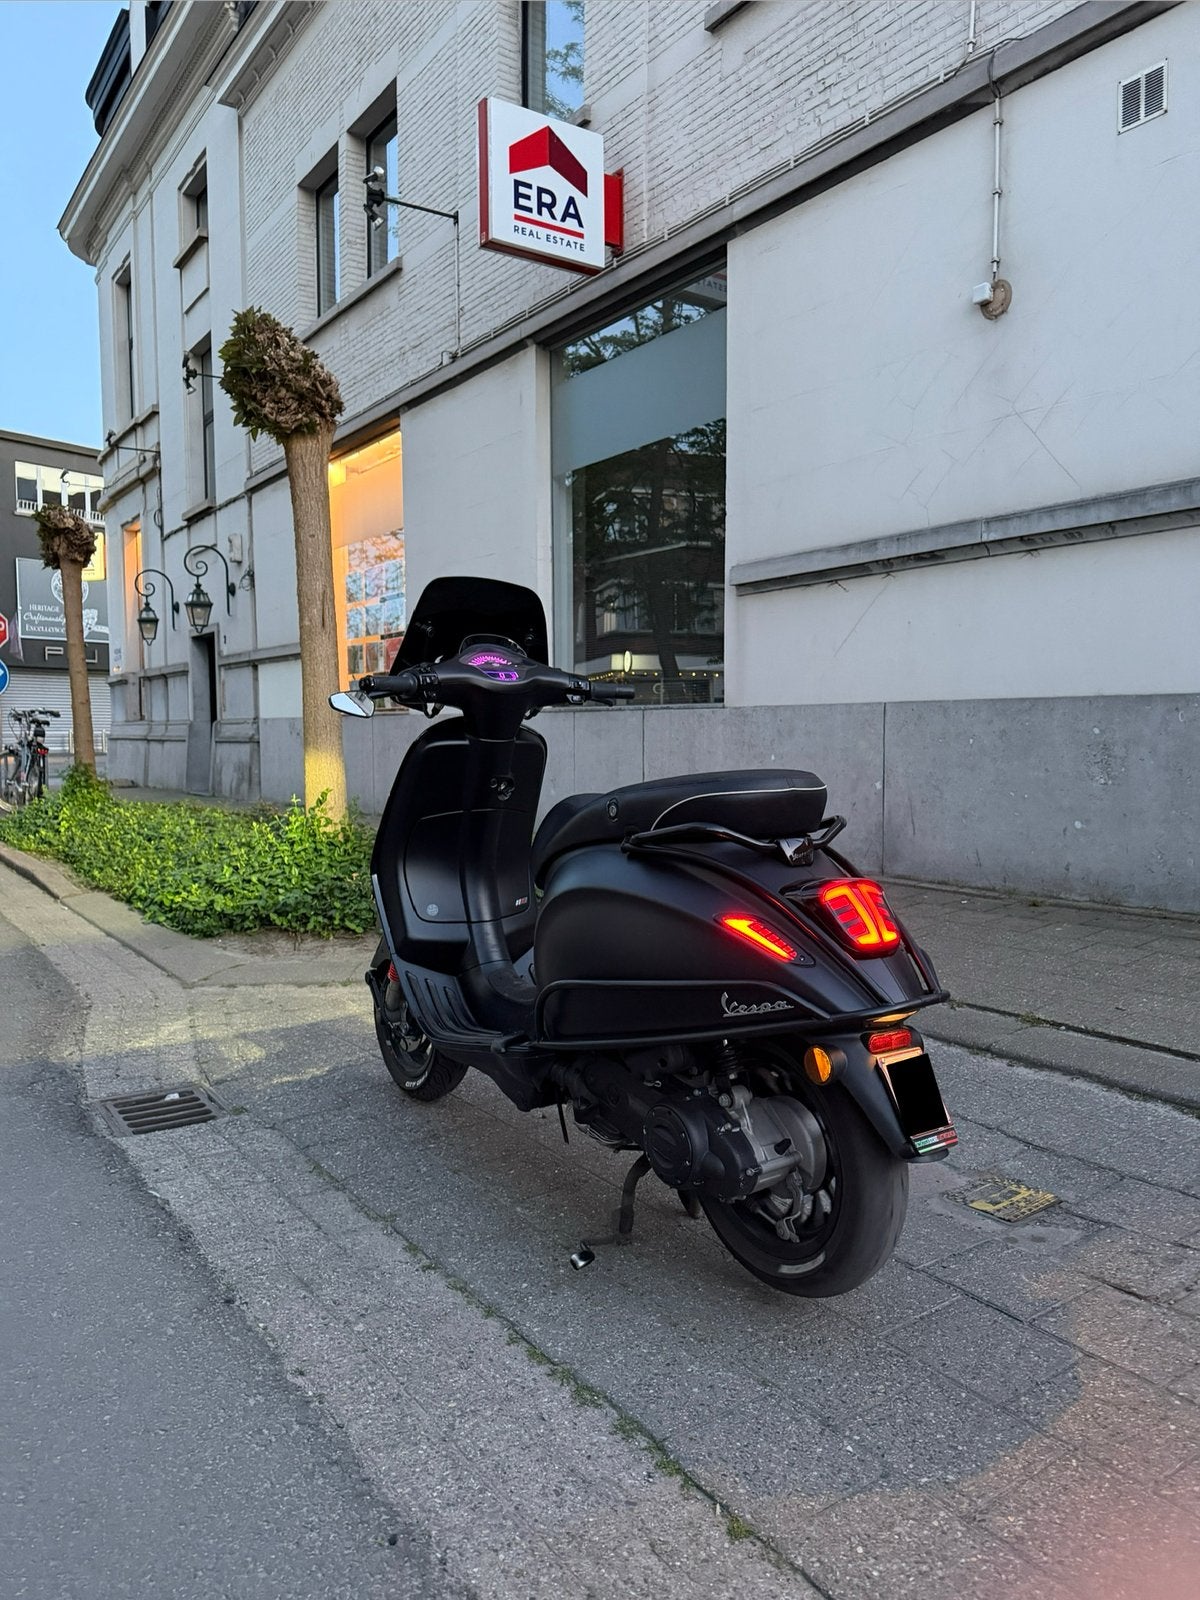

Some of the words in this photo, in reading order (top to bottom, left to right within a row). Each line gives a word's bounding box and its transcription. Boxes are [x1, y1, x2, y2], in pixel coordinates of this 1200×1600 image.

[513, 178, 585, 229] ERA
[513, 225, 541, 240] REAL
[546, 234, 585, 252] ESTATE
[721, 991, 794, 1017] Vespa
